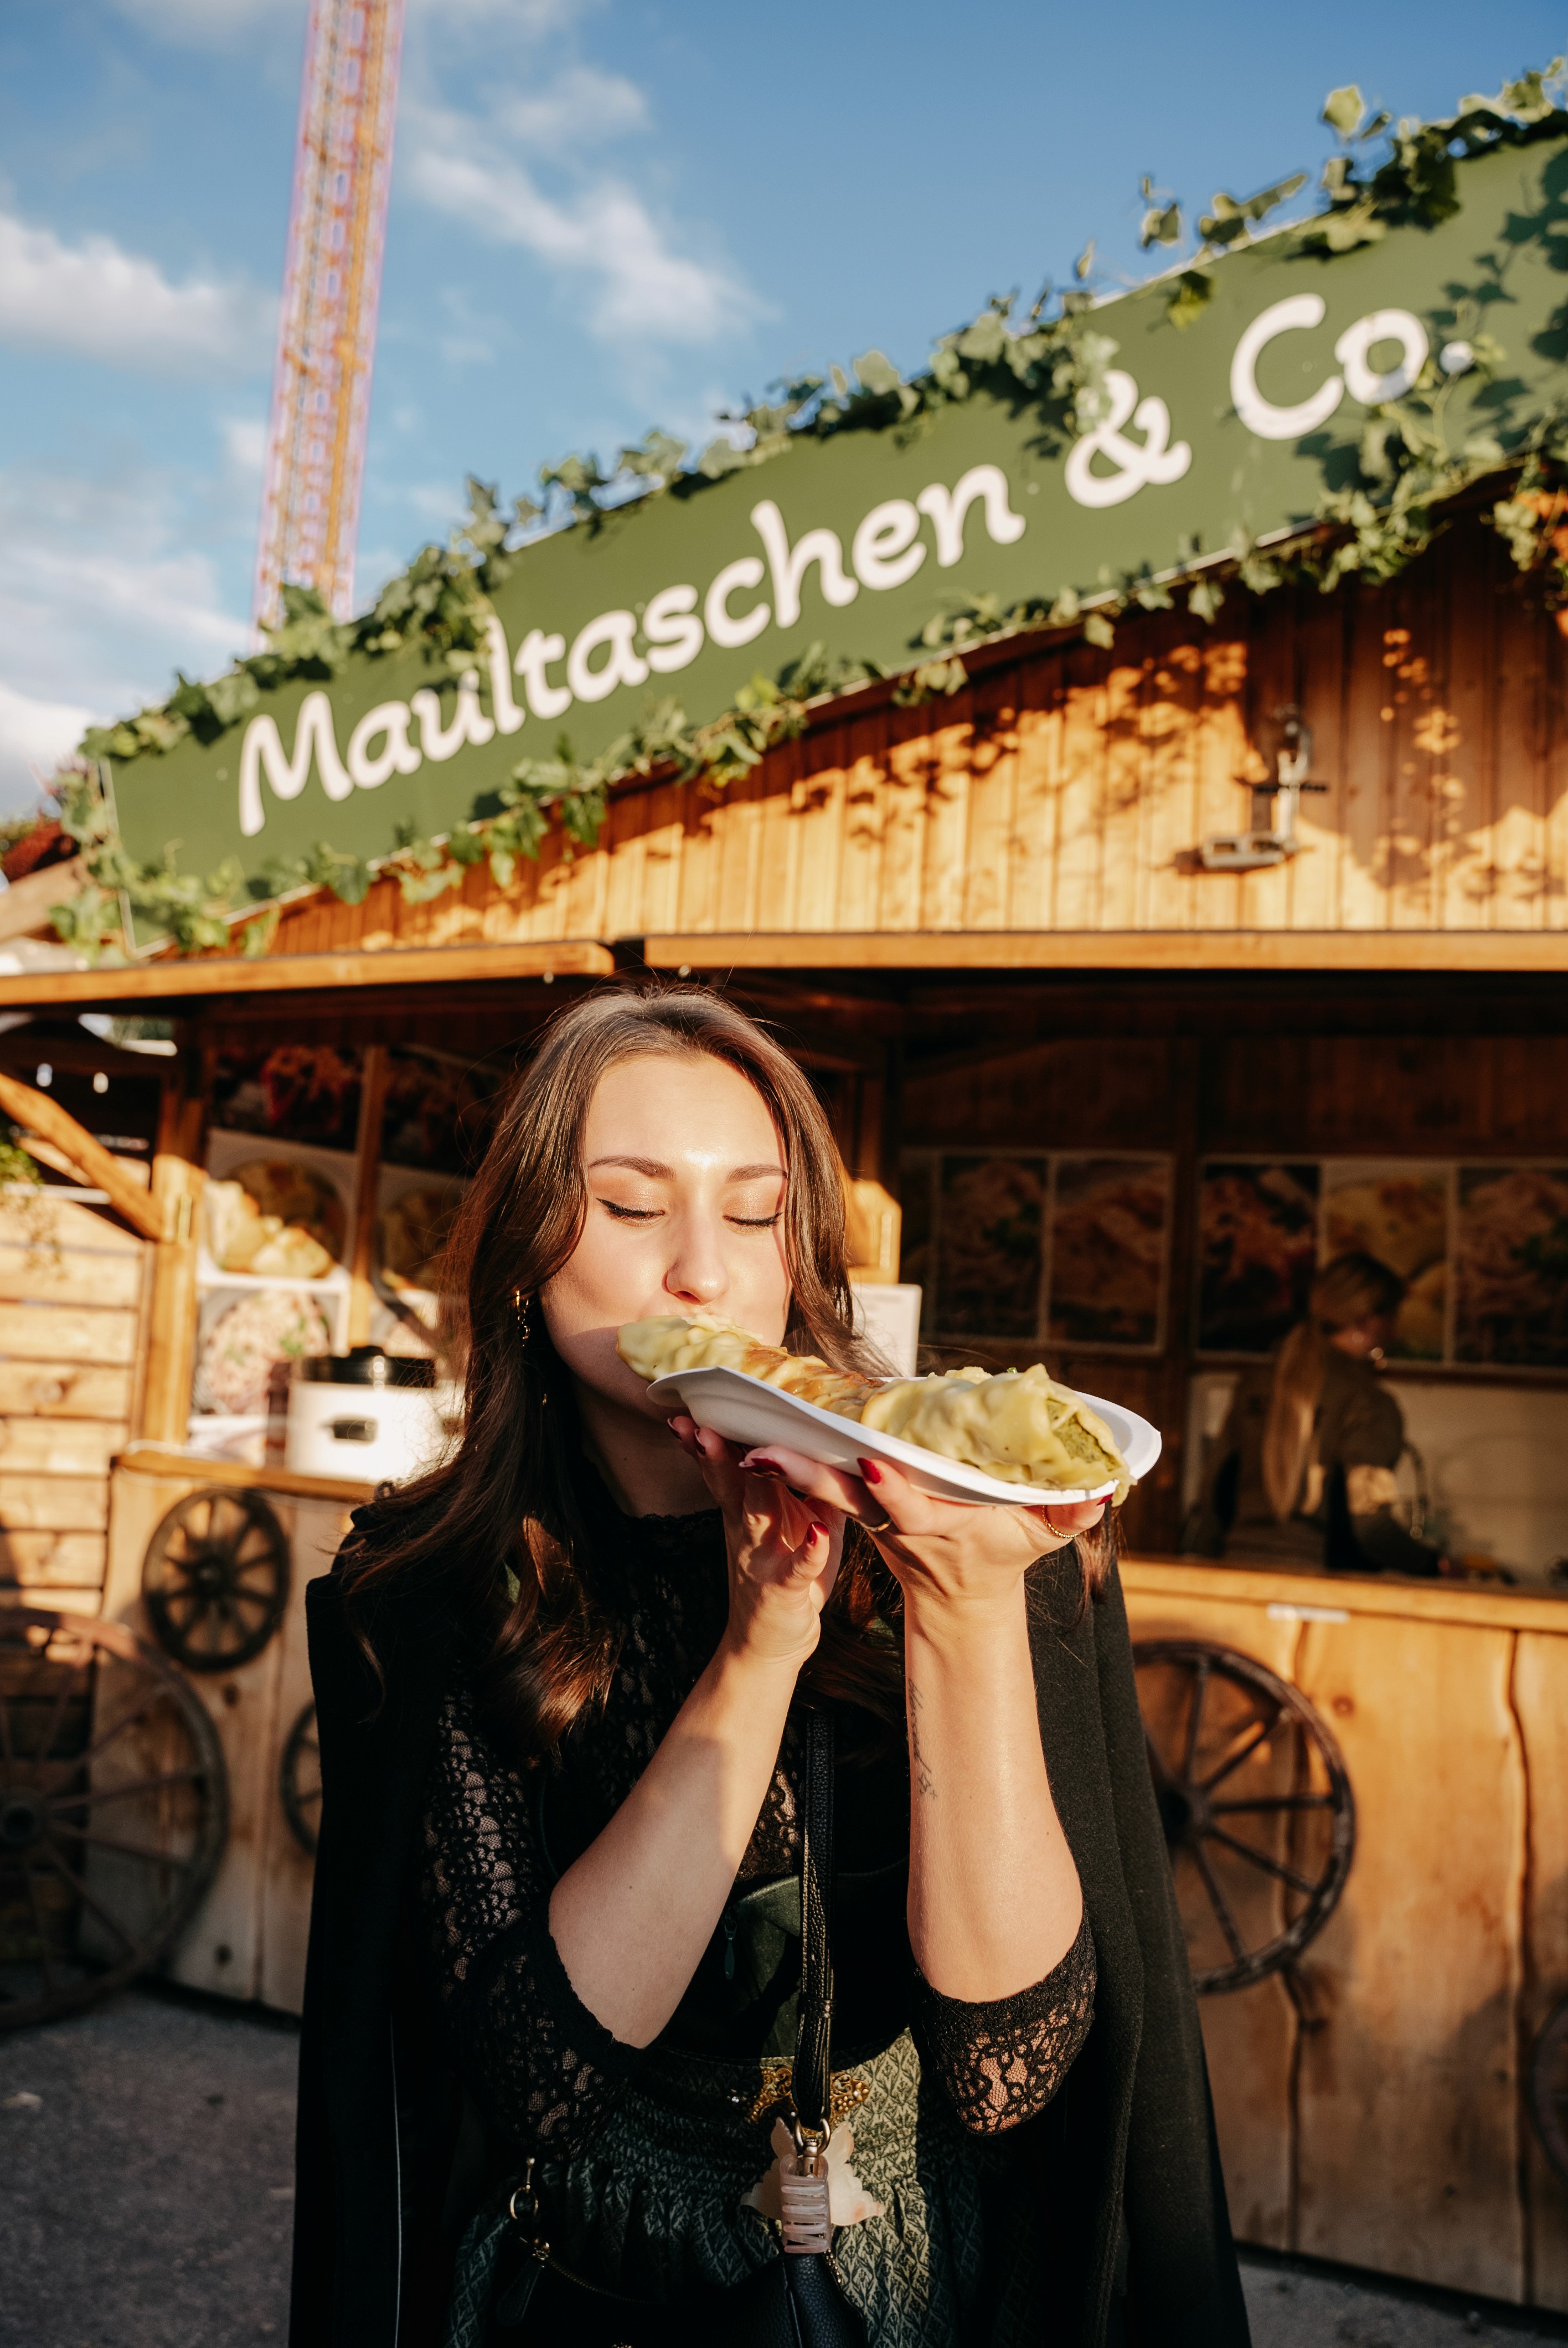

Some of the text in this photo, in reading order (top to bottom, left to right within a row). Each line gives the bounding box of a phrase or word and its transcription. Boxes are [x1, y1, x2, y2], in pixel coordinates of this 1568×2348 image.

[239, 292, 1475, 837] Maultaschen & Co.
